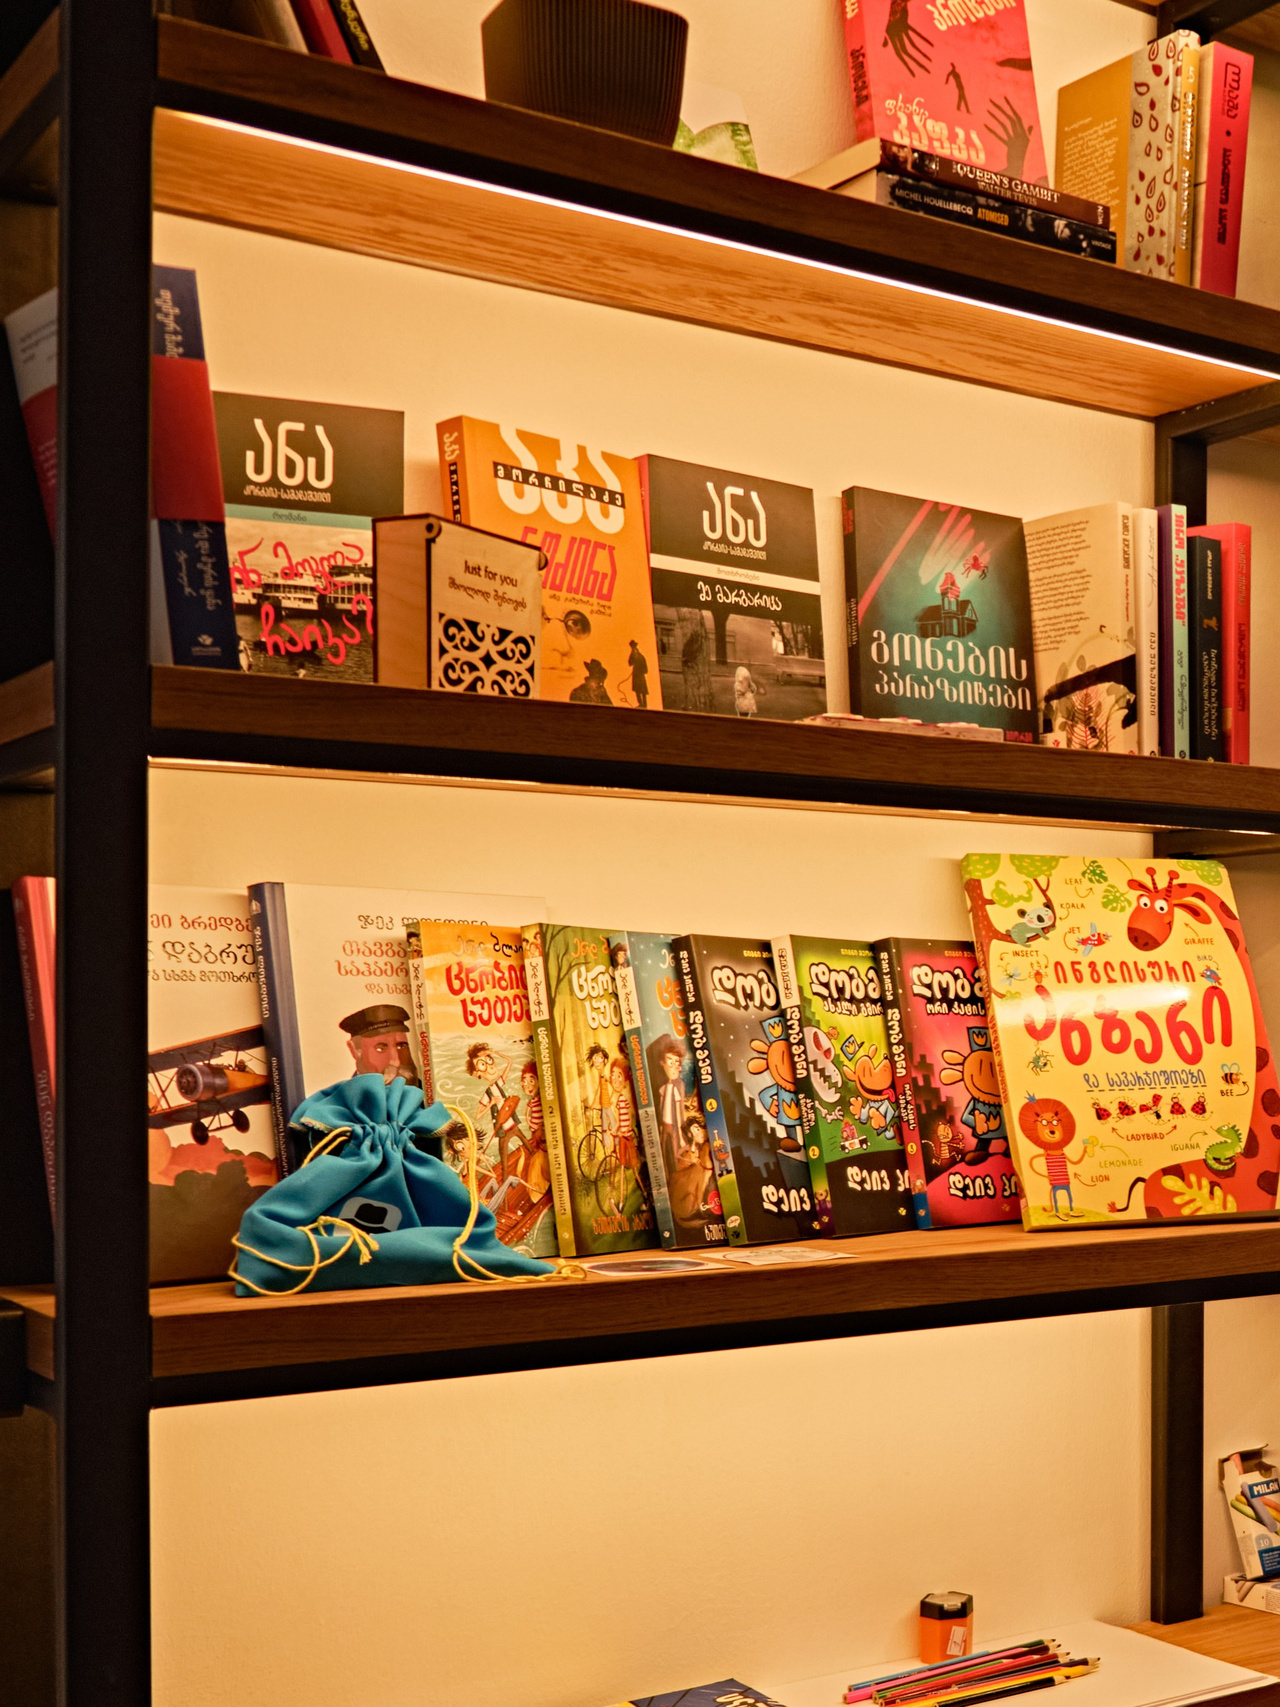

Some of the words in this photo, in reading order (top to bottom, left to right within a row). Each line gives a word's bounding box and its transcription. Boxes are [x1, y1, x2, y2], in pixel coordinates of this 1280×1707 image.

[957, 163, 1010, 189] QUEEN'S
[1012, 180, 1060, 203] GAMBIT
[977, 181, 1012, 199] WALTER
[1013, 190, 1038, 206] TEVIS
[895, 187, 923, 204] MICHEL
[924, 195, 974, 215] HOUELLEBECQ
[977, 207, 1010, 227] ATOMISED
[246, 418, 334, 489] ანა
[449, 463, 461, 522] მორჩილ
[497, 465, 622, 506] მორჩილაძე
[702, 481, 767, 548] ანა
[229, 537, 264, 594] ინ
[464, 560, 481, 577] Just
[484, 566, 498, 582] for
[500, 574, 517, 587] you
[697, 581, 712, 602] მე
[715, 584, 783, 611] მარგარიტა
[871, 629, 1028, 681] გონების
[874, 669, 1032, 711] პარაზიტები
[1064, 878, 1083, 886] LEAF
[1060, 902, 1086, 911] KOALA
[150, 913, 172, 929] ეი
[358, 914, 394, 930] ჯეკ
[162, 940, 256, 965] დაბრუ
[342, 940, 408, 958] თავგა
[490, 932, 523, 957] ბლაი
[1184, 937, 1215, 946] GIRAFFE
[1012, 950, 1040, 958] INSECT
[200, 970, 258, 983] მოთხრო
[336, 959, 409, 978] საჰაერ
[445, 960, 528, 996] ცნობი
[1053, 960, 1197, 985] ინგლისური
[364, 983, 383, 994] და
[460, 994, 532, 1028] ხუთე
[860, 1002, 884, 1017] გმირ
[926, 1001, 948, 1014] ორი
[952, 1001, 985, 1016] კატის
[1083, 1074, 1100, 1087] და
[1107, 1069, 1208, 1088] სავარჯიშოები
[1219, 1089, 1235, 1097] BEE
[1126, 1132, 1166, 1142] LADYBIRD
[1170, 1142, 1201, 1151] IGUANA
[1098, 1158, 1144, 1168] LEMONADE
[848, 1165, 891, 1192] დეივ
[949, 1172, 997, 1199] დეივ
[1090, 1174, 1110, 1183] LION
[762, 1184, 811, 1214] დეივ
[1253, 1480, 1280, 1496] MILAN
[1260, 1538, 1270, 1547] 10
